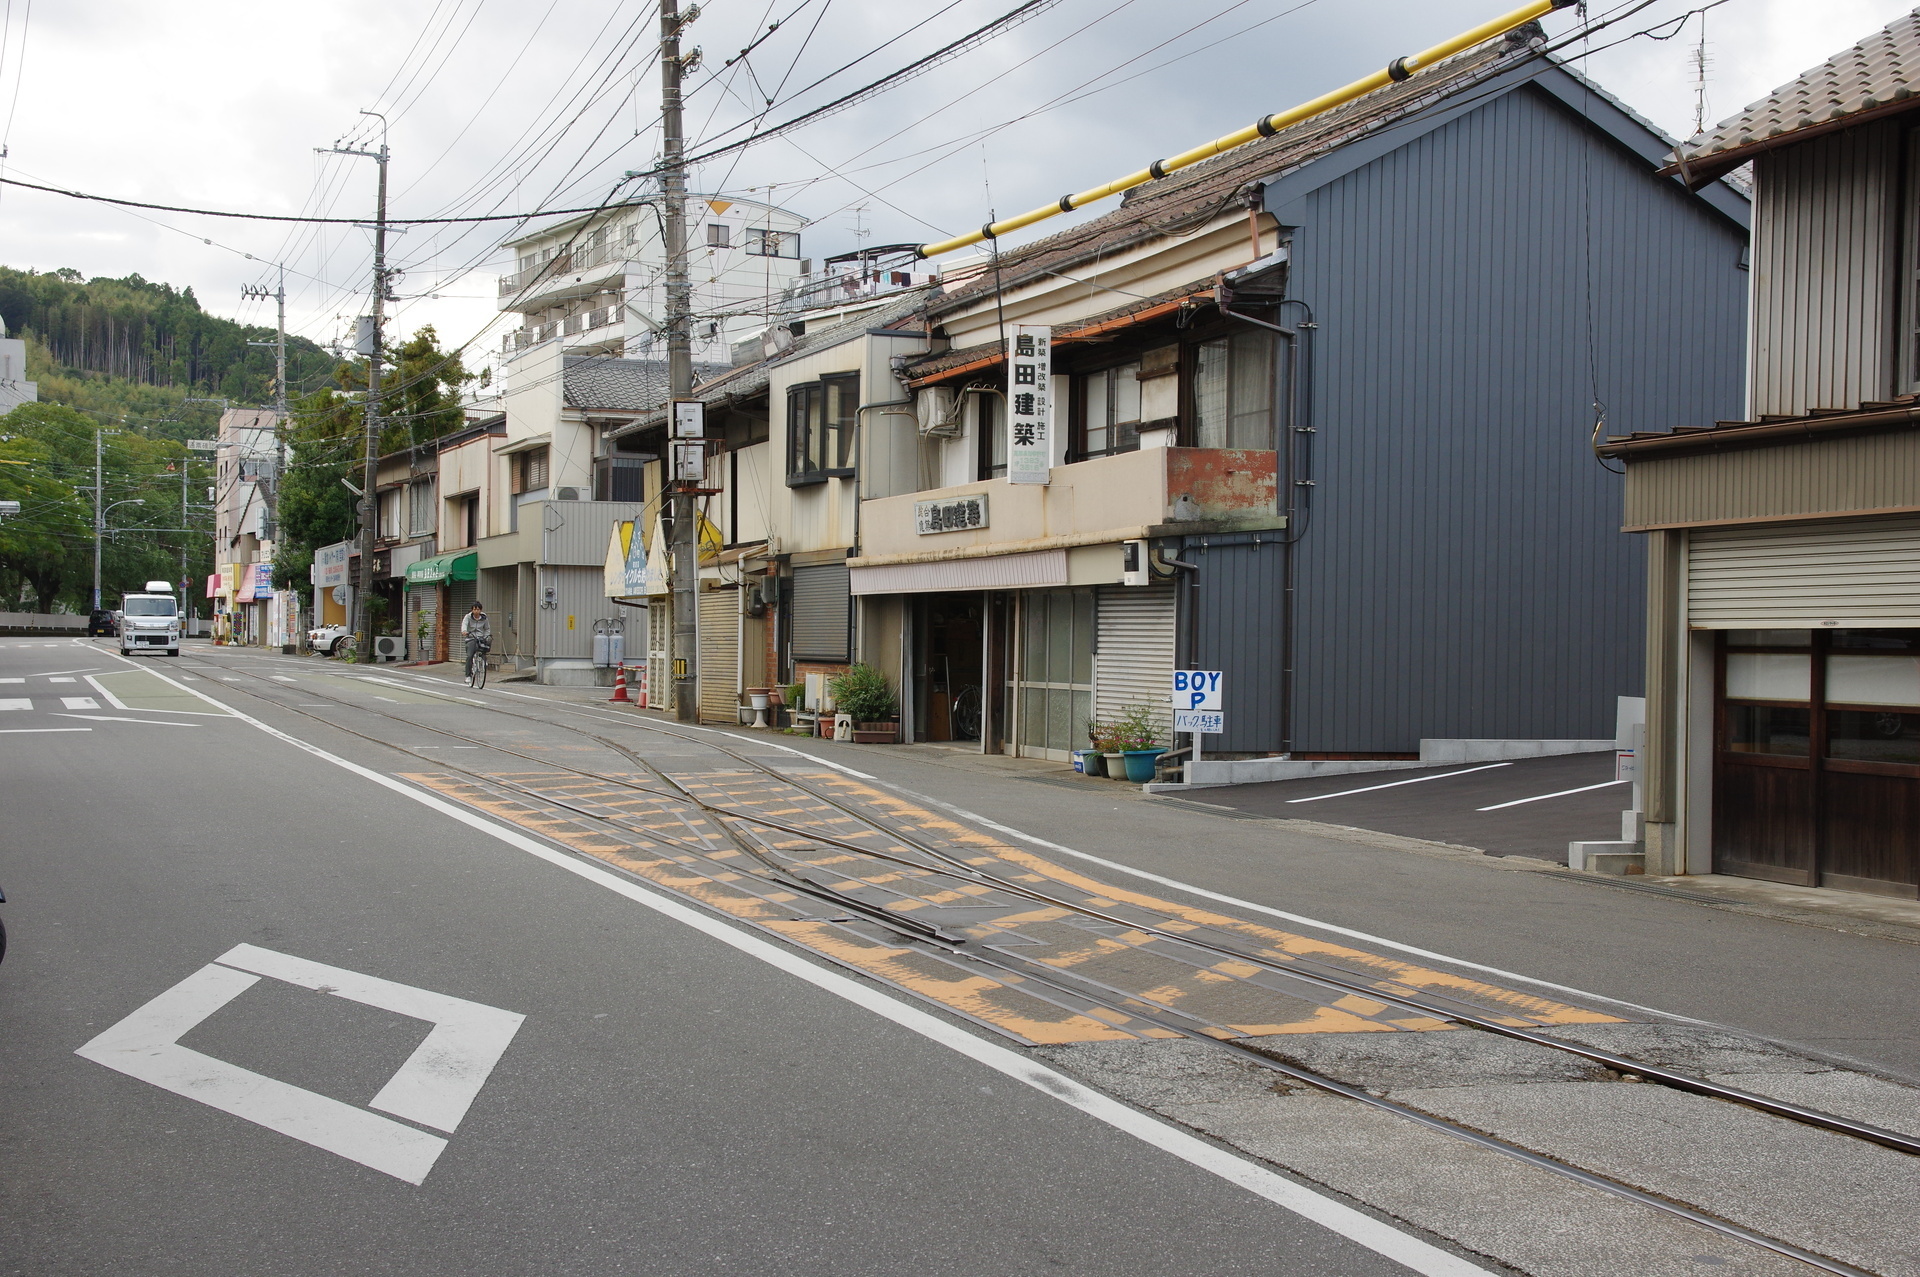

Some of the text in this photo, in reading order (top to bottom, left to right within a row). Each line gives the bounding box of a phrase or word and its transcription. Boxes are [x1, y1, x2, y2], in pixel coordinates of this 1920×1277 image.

[1014, 333, 1036, 447] 島田建築
[1174, 671, 1221, 692] BOY
[1190, 692, 1206, 709] P
